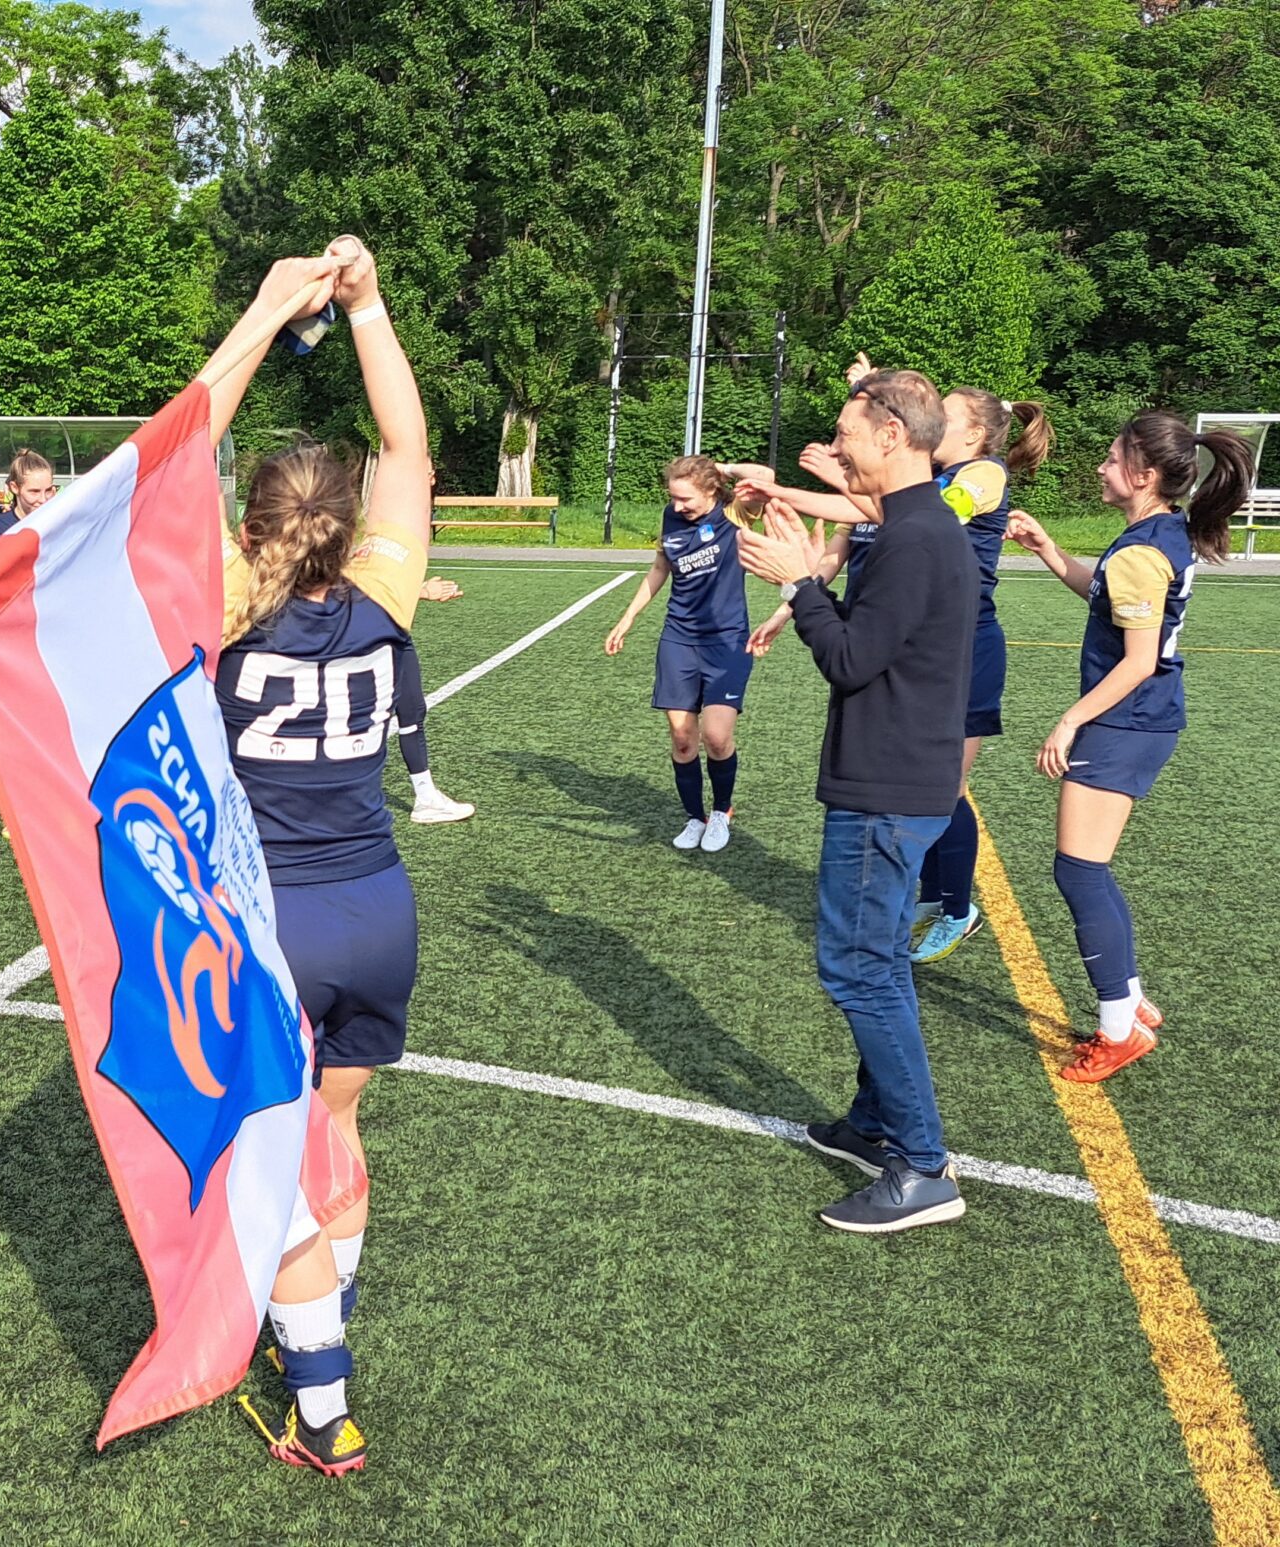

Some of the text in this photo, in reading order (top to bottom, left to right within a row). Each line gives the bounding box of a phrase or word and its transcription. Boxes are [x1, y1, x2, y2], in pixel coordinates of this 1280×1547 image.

[678, 544, 720, 565] STUDENTS
[679, 563, 692, 574] GO
[691, 554, 715, 569] WEST
[235, 644, 395, 761] 20
